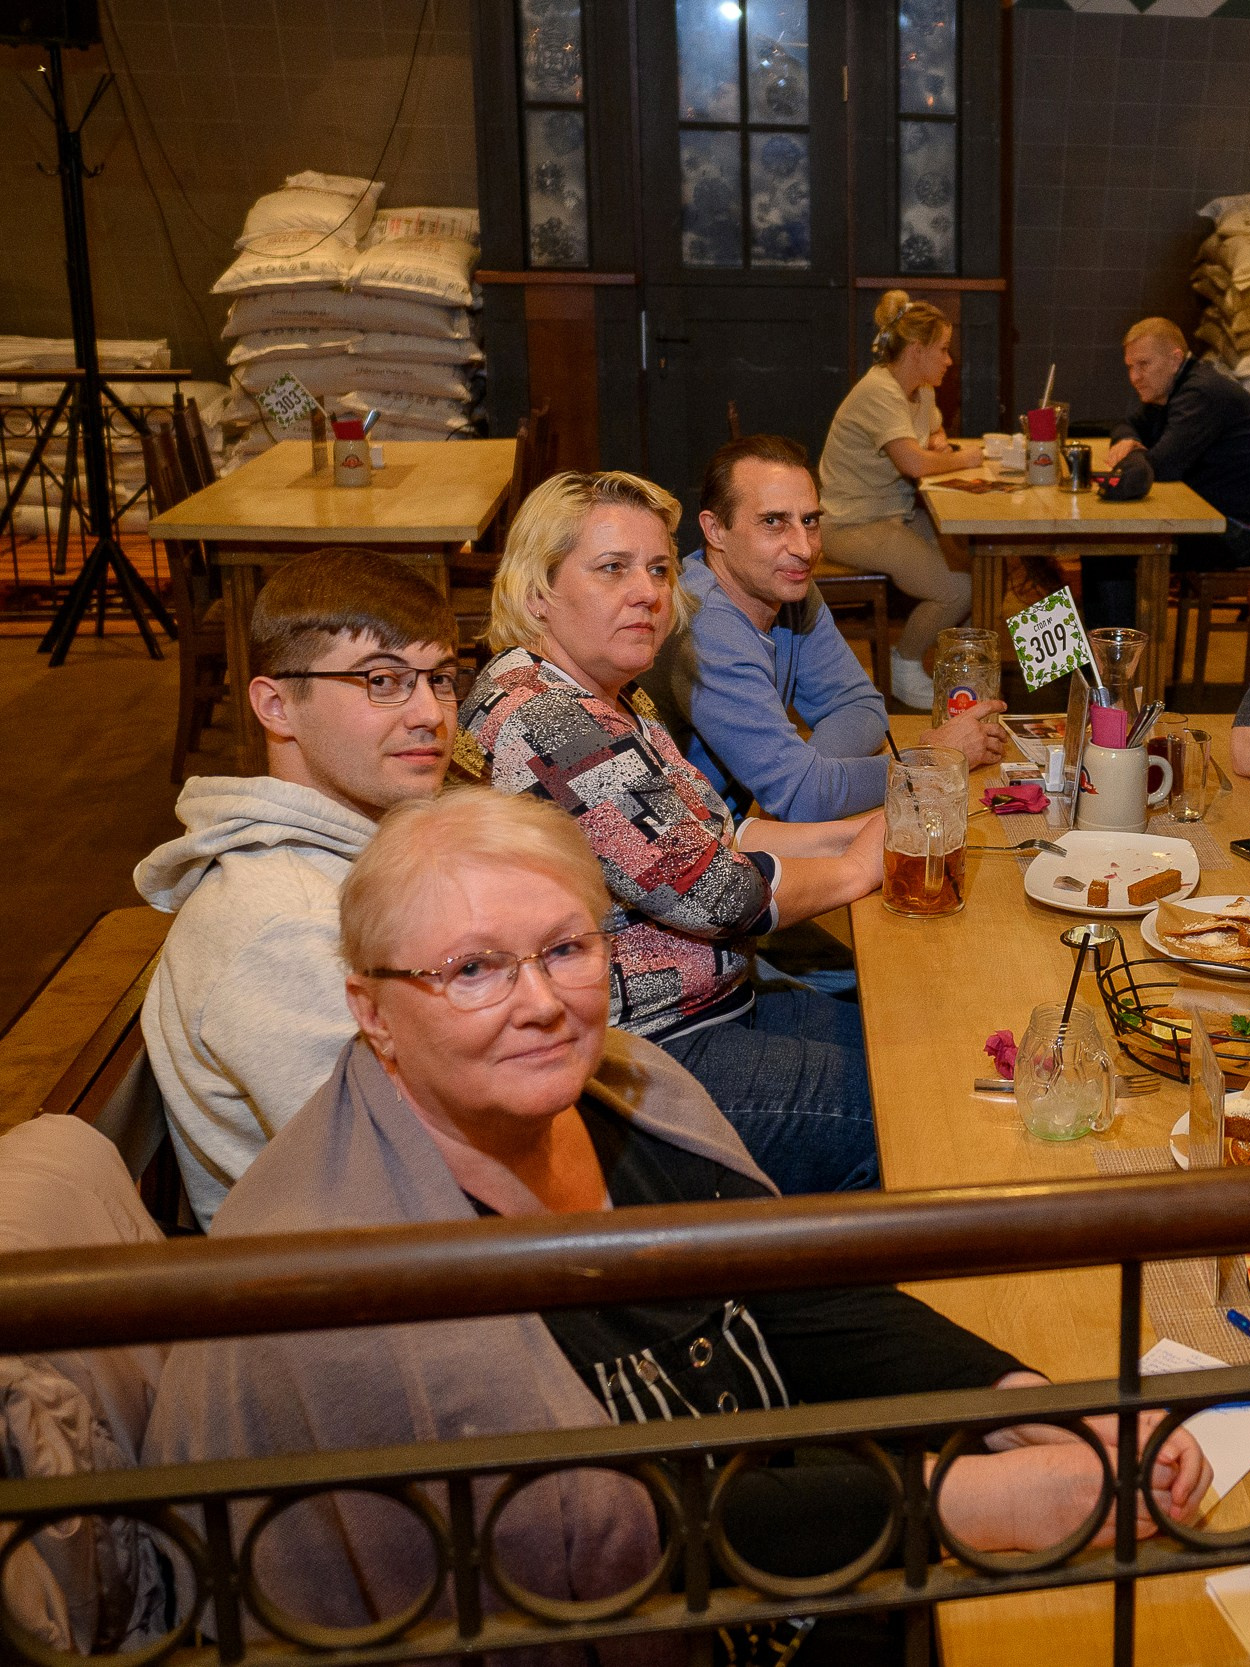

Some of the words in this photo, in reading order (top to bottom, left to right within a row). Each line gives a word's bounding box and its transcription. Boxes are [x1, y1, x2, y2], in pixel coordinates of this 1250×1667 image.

[274, 390, 303, 416] 303
[1033, 620, 1048, 633] СТОЛ
[1030, 623, 1068, 664] 309
